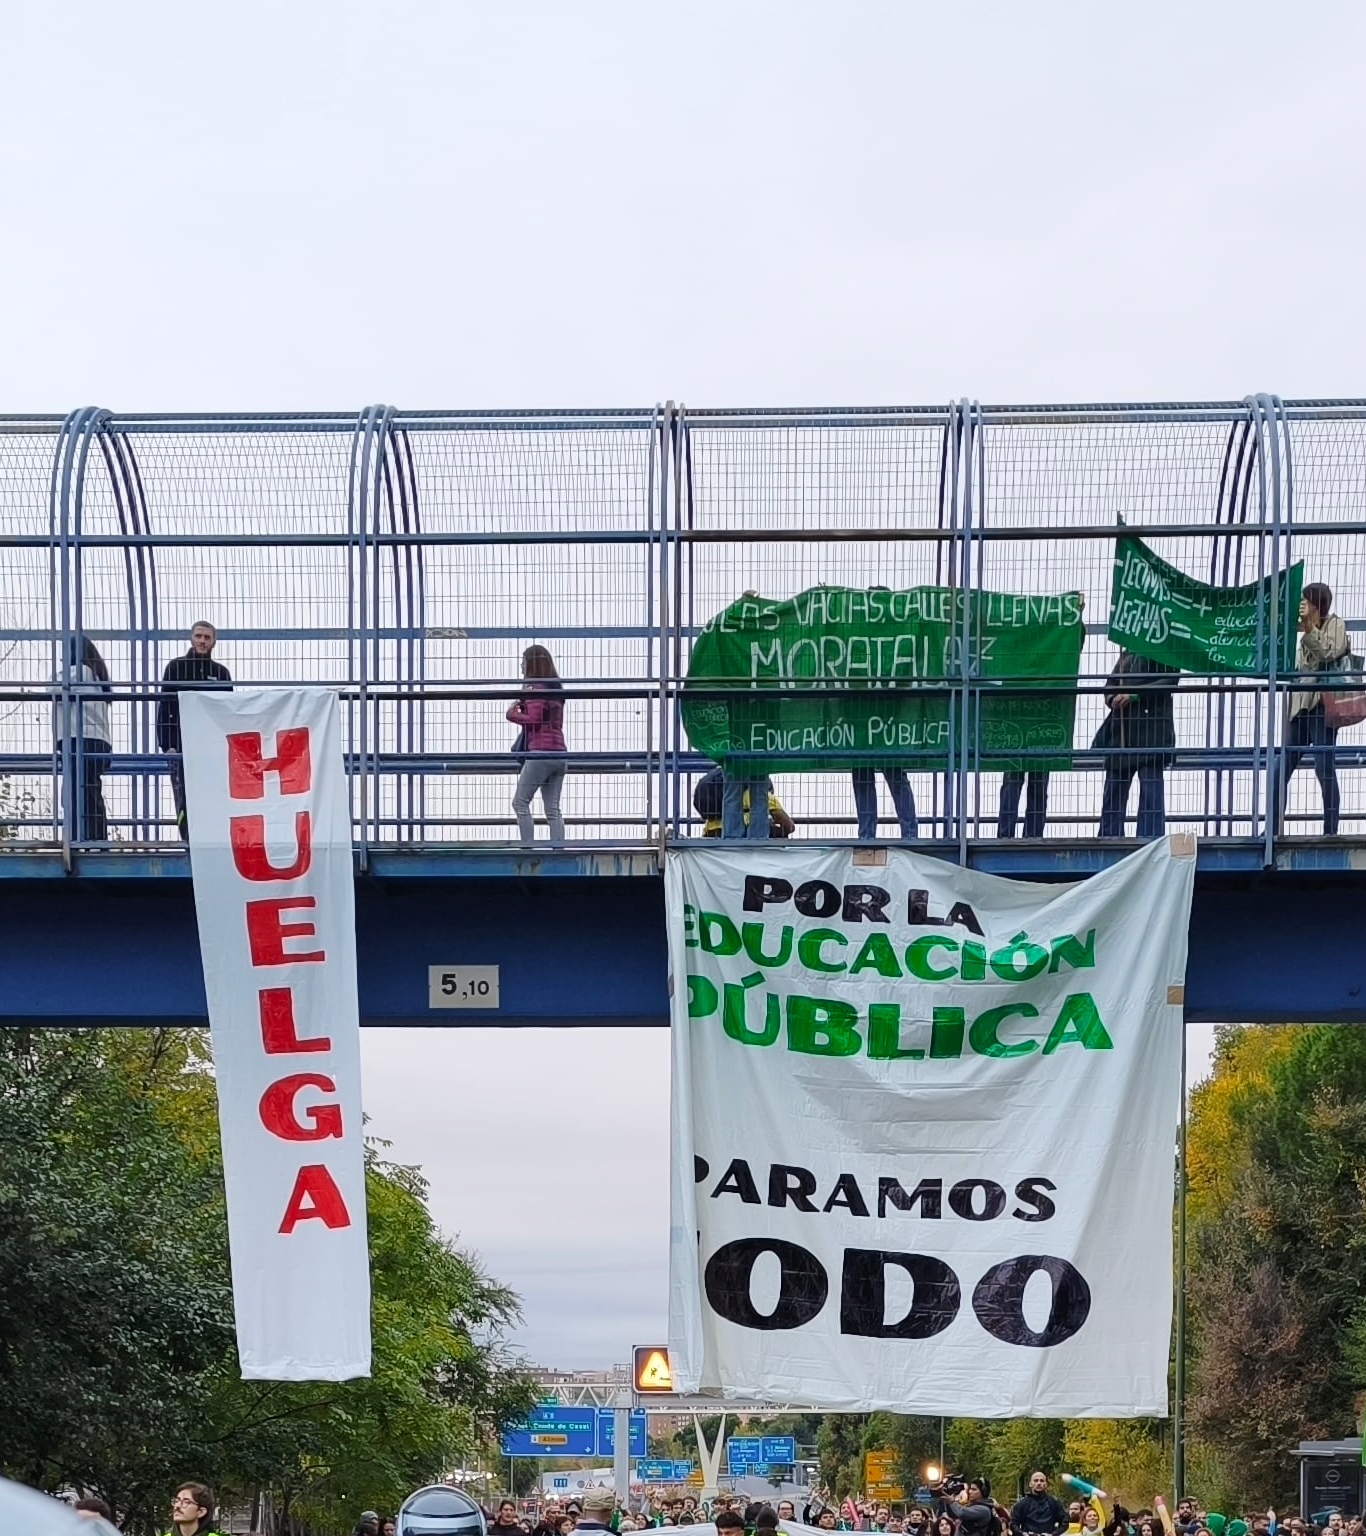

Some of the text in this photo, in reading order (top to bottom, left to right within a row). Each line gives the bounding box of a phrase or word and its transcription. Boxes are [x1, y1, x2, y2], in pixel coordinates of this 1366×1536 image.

[702, 602, 781, 633] ULAS
[986, 593, 1082, 627] LLENAS
[750, 717, 855, 752] EDUCACIÓN
[742, 875, 985, 936] POR LA
[226, 726, 352, 1235] HUELGA
[697, 1229, 1092, 1348] ODO
